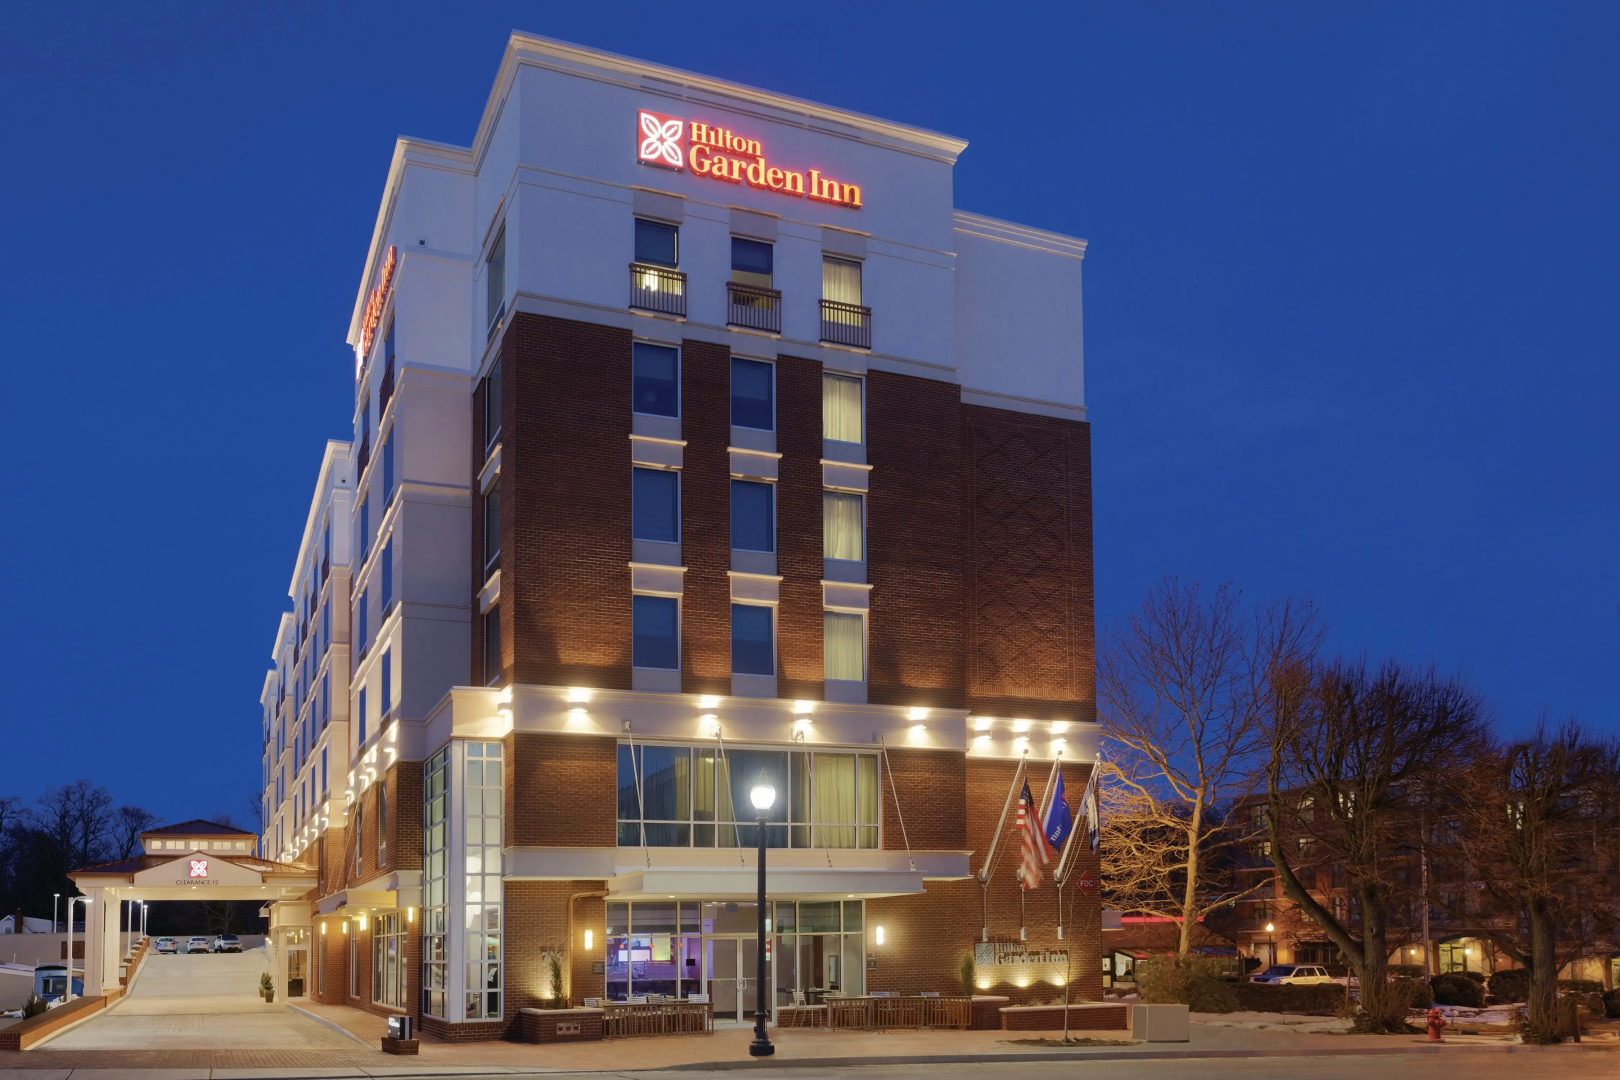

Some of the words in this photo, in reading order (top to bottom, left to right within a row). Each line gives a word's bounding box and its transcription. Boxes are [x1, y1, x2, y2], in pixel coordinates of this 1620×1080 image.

[690, 121, 762, 156] Hilton
[689, 145, 806, 194] Garden
[809, 168, 863, 206] Inn
[1080, 879, 1094, 887] FDC
[996, 952, 1043, 965] Garden
